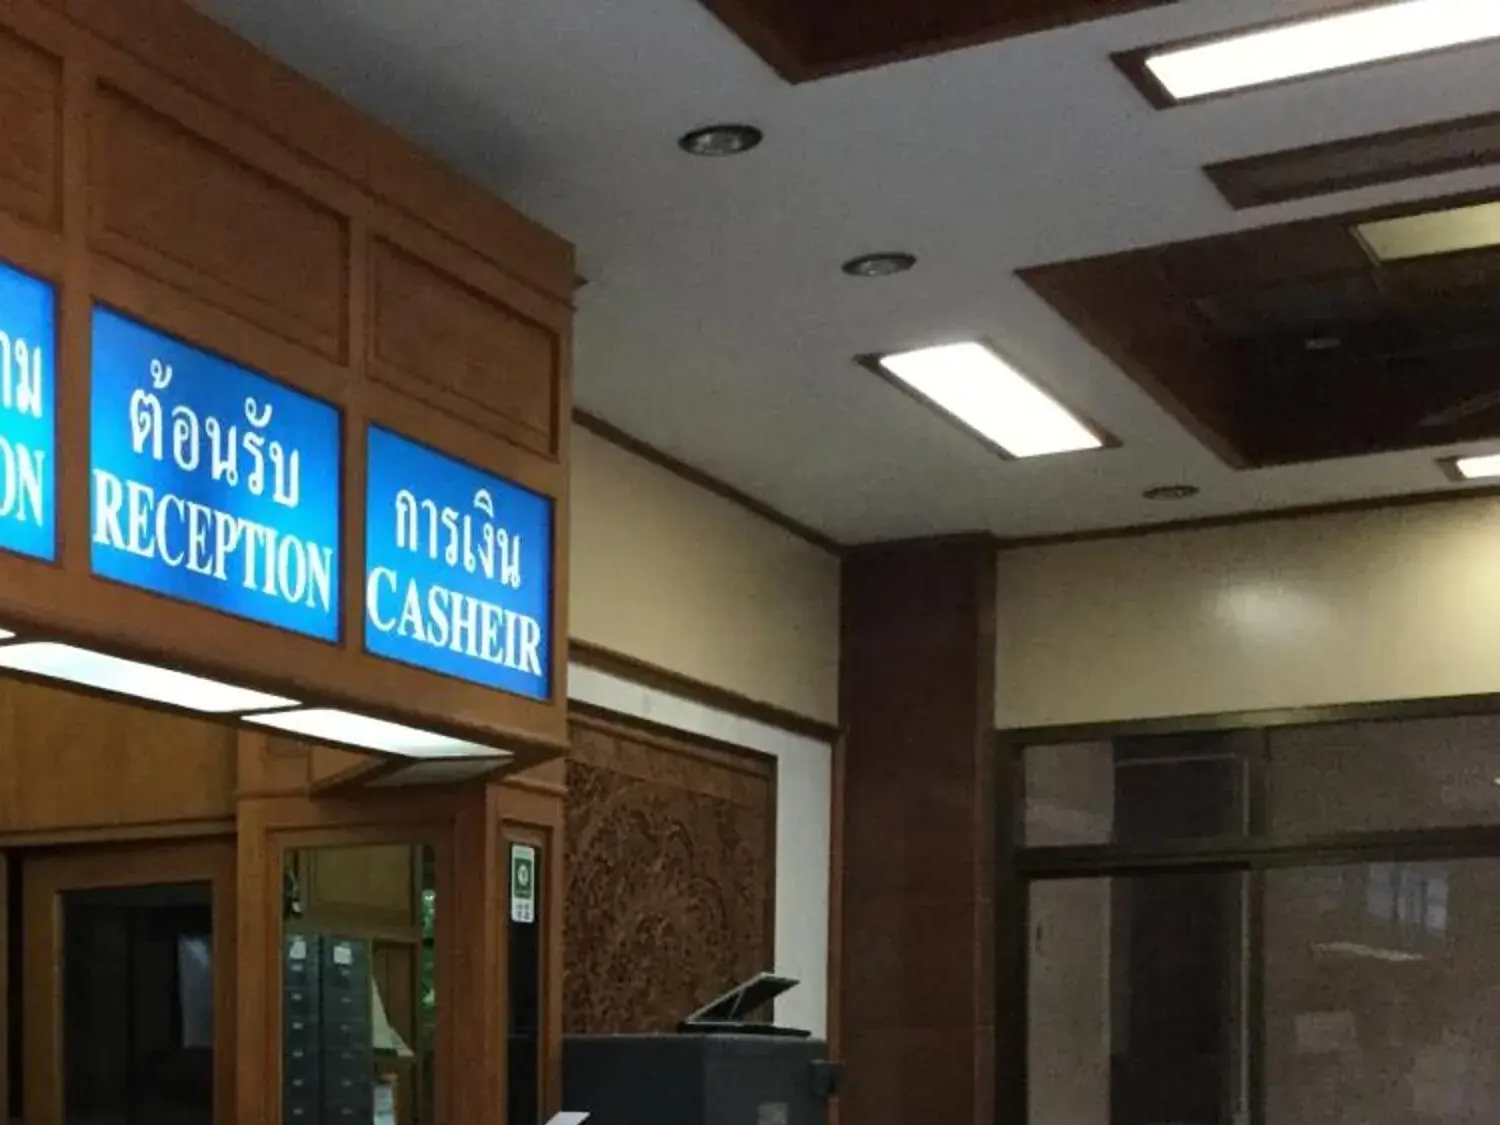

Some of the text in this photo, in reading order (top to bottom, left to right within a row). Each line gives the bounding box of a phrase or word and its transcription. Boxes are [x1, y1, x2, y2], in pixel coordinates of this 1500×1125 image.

[128, 358, 300, 509] ต้อนรับ
[91, 467, 333, 613] RECEPTION
[394, 487, 522, 590] การเงิน
[366, 565, 544, 676] CASHEIR
